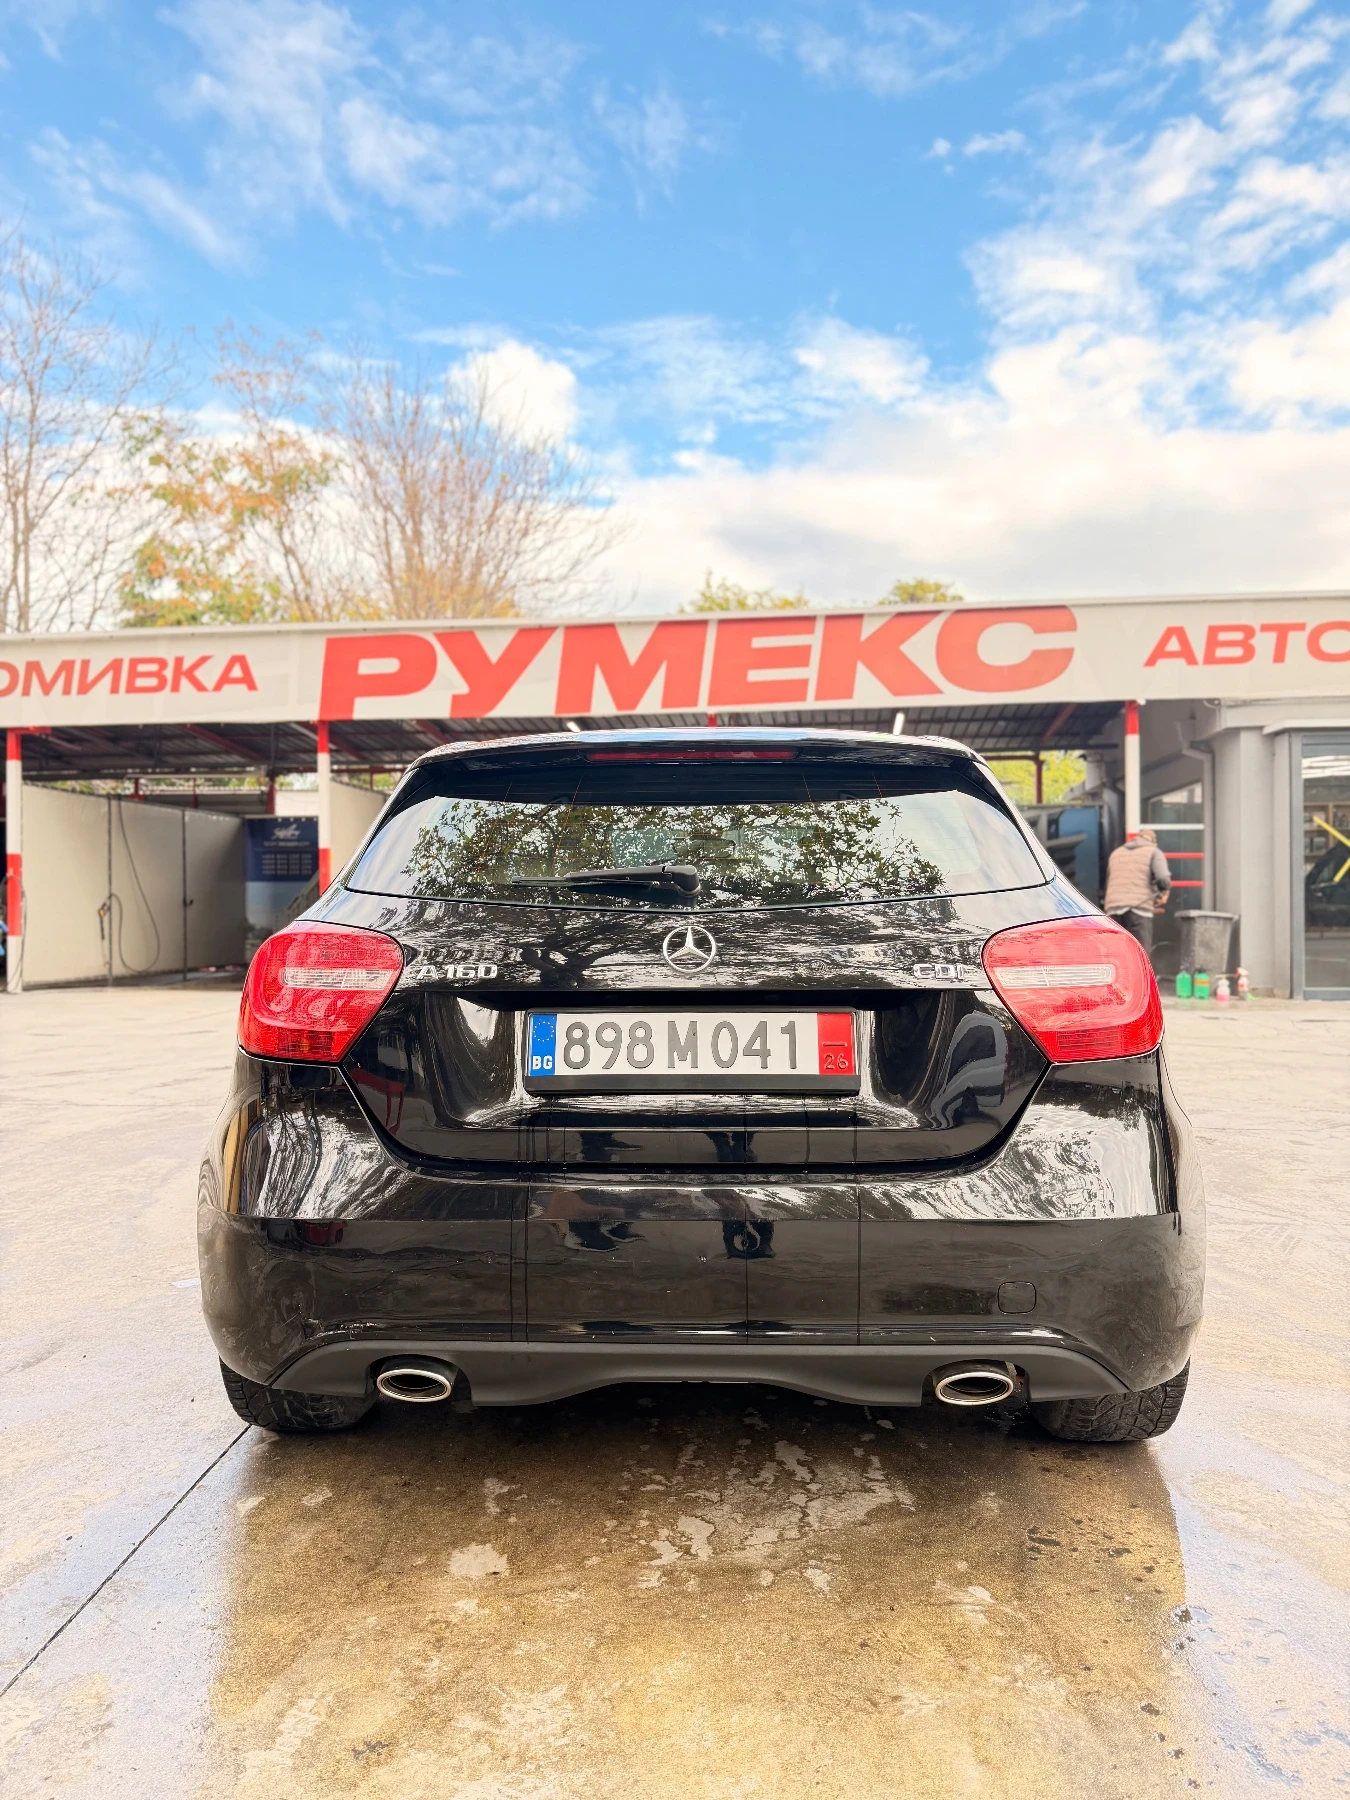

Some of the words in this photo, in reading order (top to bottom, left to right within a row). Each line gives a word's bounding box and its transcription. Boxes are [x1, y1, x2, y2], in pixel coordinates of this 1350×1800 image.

[319, 605, 1077, 720] РУМЕКС
[913, 963, 965, 979] CDI
[532, 1055, 553, 1070] BG
[823, 1053, 849, 1070] 26
